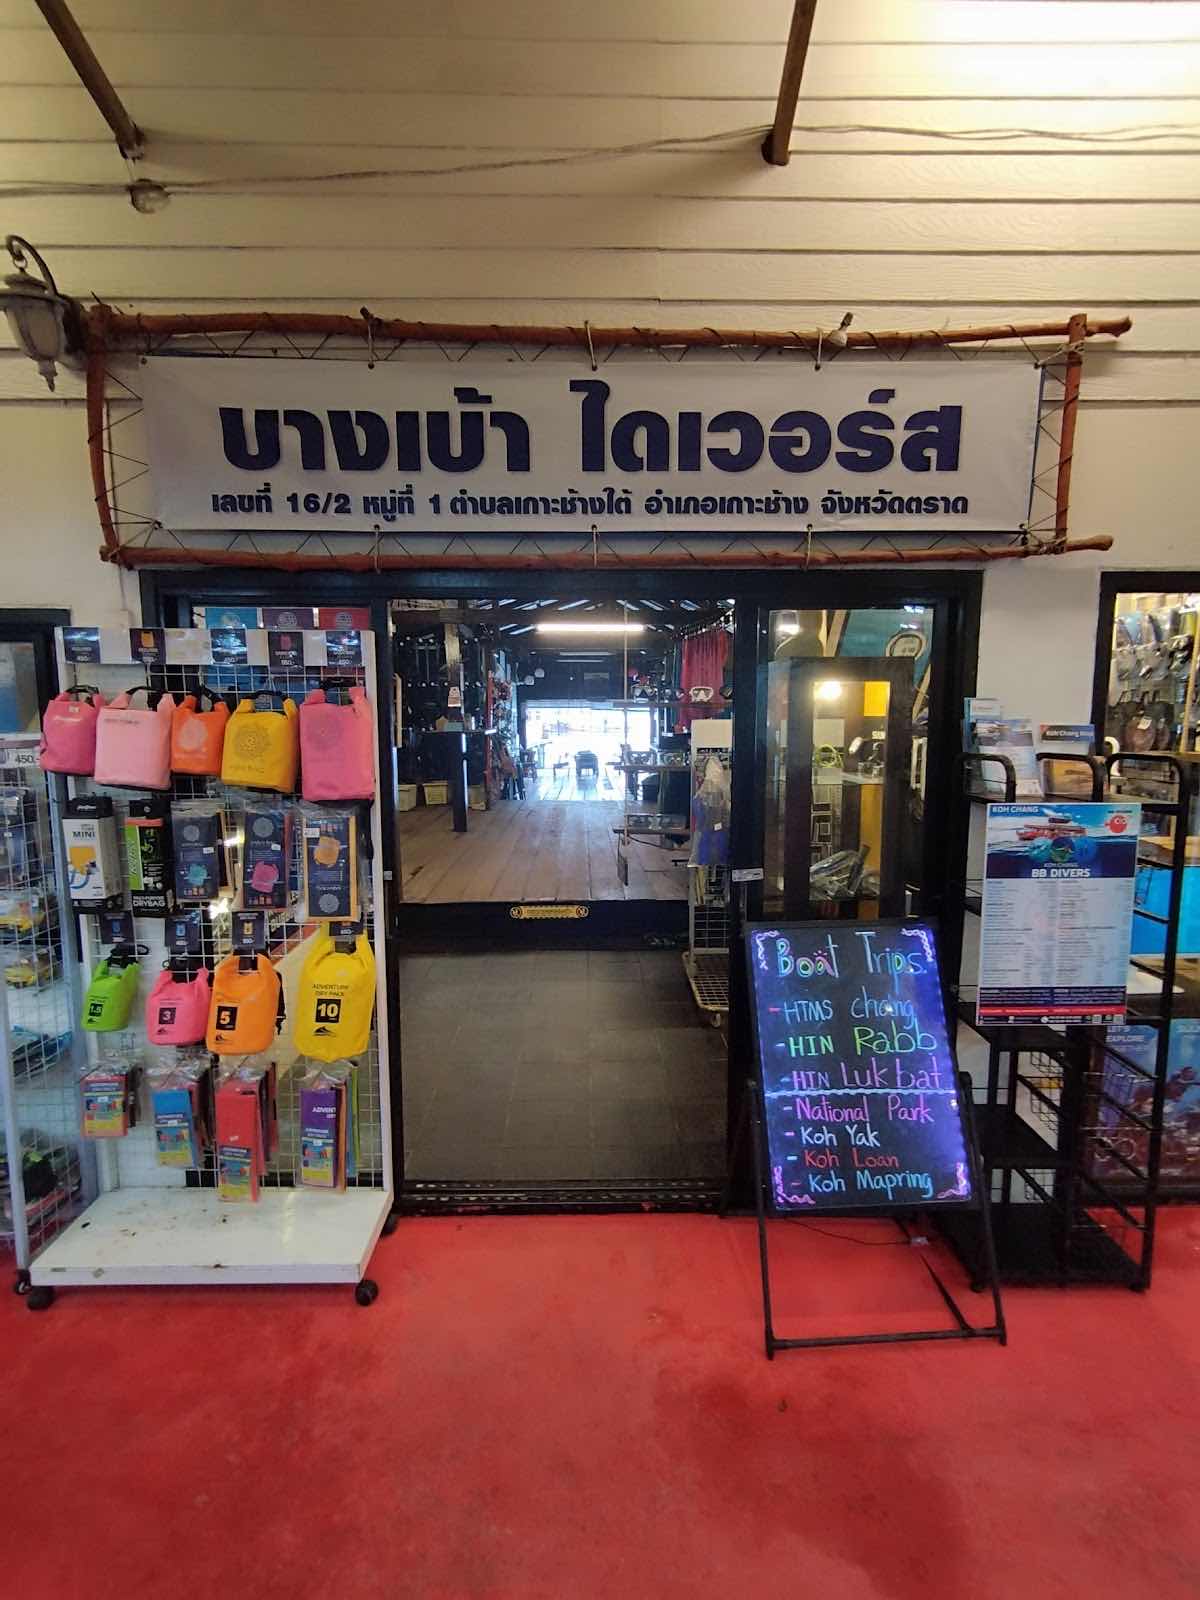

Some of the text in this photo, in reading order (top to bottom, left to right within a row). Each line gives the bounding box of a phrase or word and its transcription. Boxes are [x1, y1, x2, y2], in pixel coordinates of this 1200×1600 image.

[219, 379, 963, 473] บางเบ้า ไดเวอร์ส
[211, 482, 969, 522] เลขที่ 16/2 หมู่ที่ 1 ตำบลเกาะช้างใต้ อำเภอเกาะช้าง จังหวัดตราด
[72, 830, 96, 838] MINI
[1031, 869, 1091, 878] BB DIVERS
[776, 934, 839, 978] Boat
[161, 1011, 171, 1021] 3
[219, 1011, 231, 1025] 5
[317, 1003, 339, 1018] 10
[784, 999, 833, 1024] HTMS
[789, 1018, 937, 1058] HIN Rabb
[792, 1071, 830, 1091] HIN
[841, 1057, 888, 1088] Luk
[796, 1094, 935, 1123] National Park
[801, 1124, 880, 1147] Koh Yak
[804, 1148, 899, 1169] Koh Loan
[808, 1170, 933, 1200] Koh Mapring
